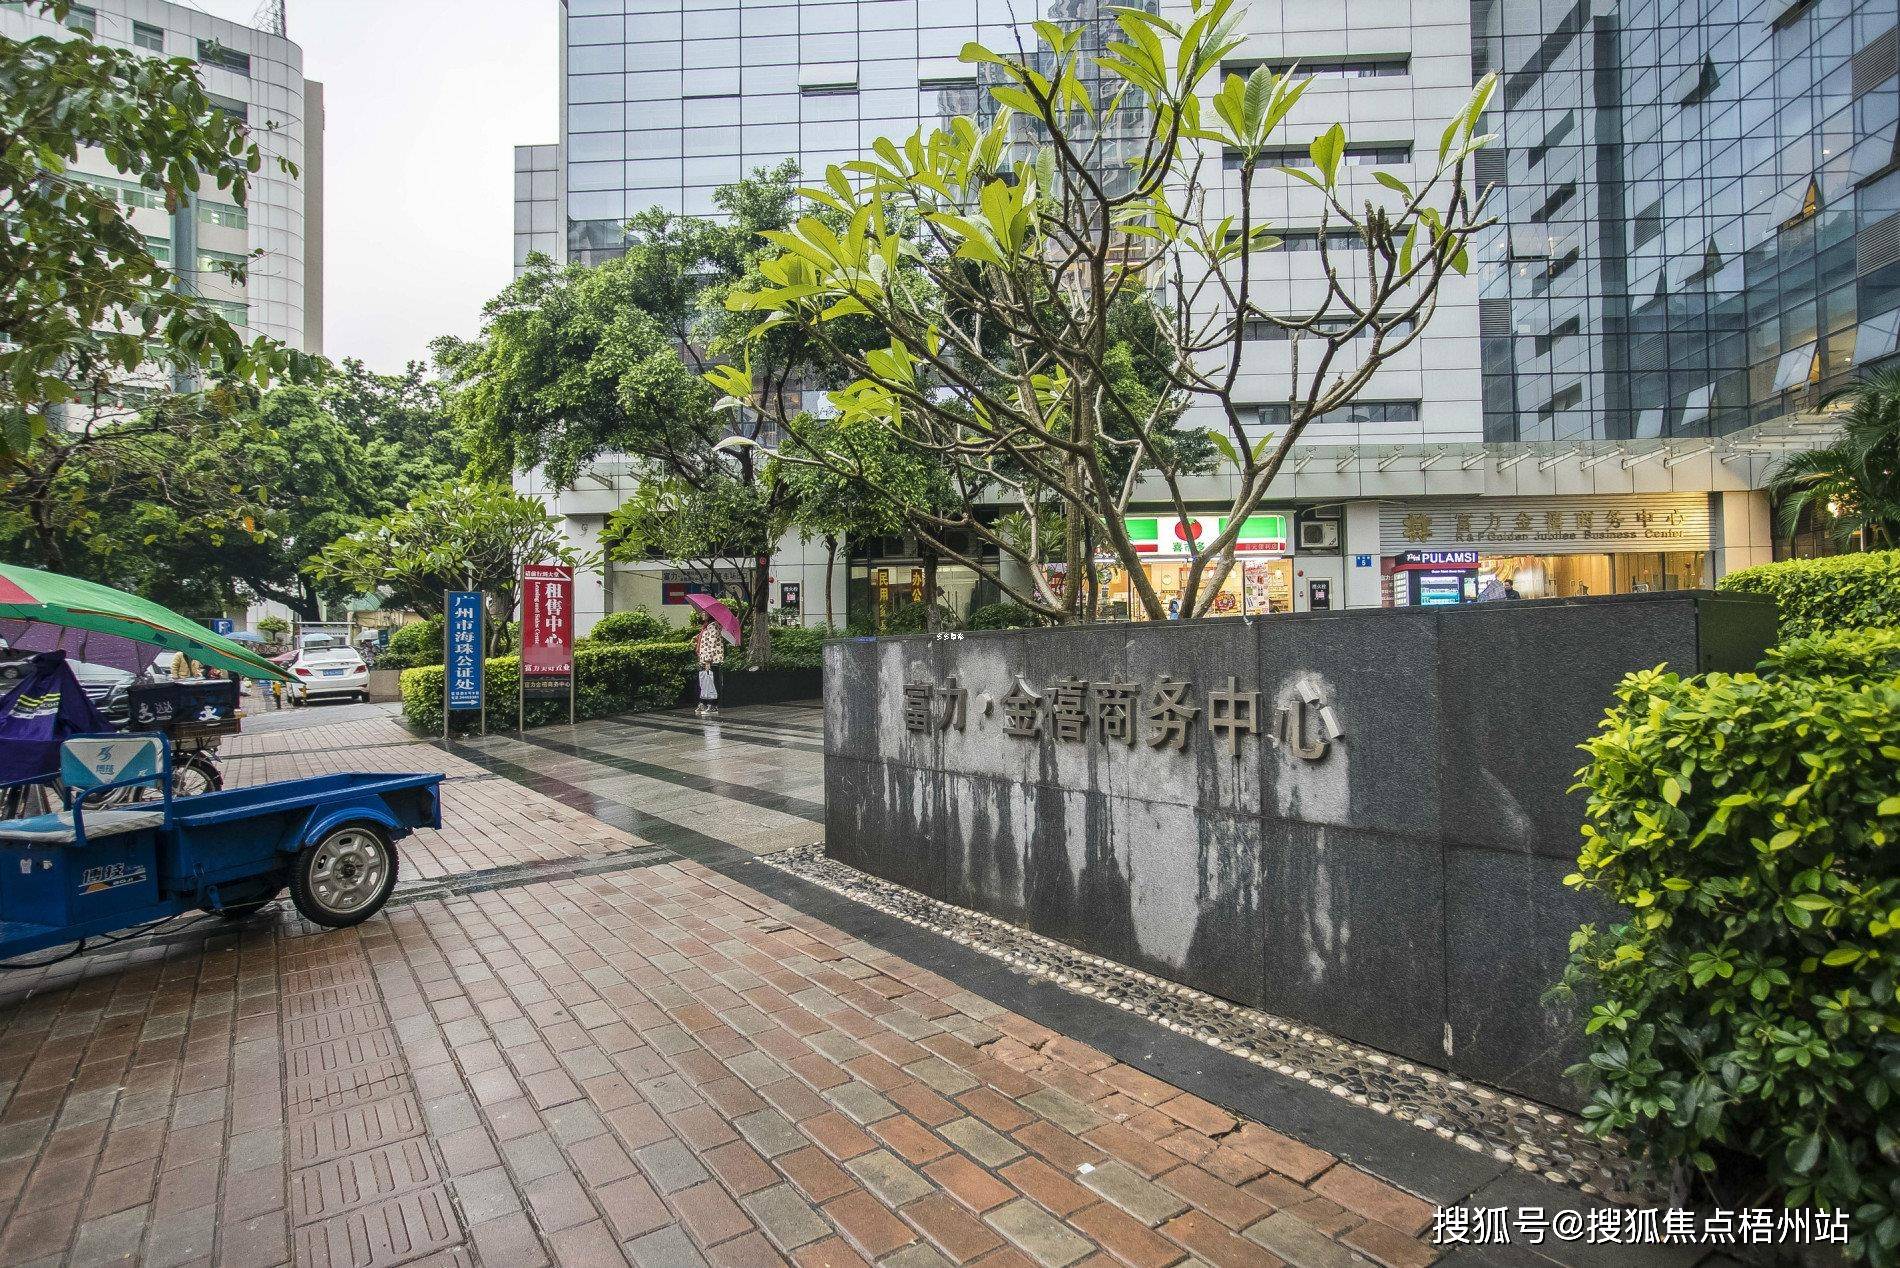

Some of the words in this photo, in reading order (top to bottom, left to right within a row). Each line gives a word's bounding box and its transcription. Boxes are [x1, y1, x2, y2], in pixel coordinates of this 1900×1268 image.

[1584, 529, 1637, 540] Business
[1645, 528, 1683, 539] Center
[1422, 552, 1475, 563] PULAMSI
[545, 582, 563, 647] 租售中心
[454, 595, 475, 690] 广州市海珠公证处
